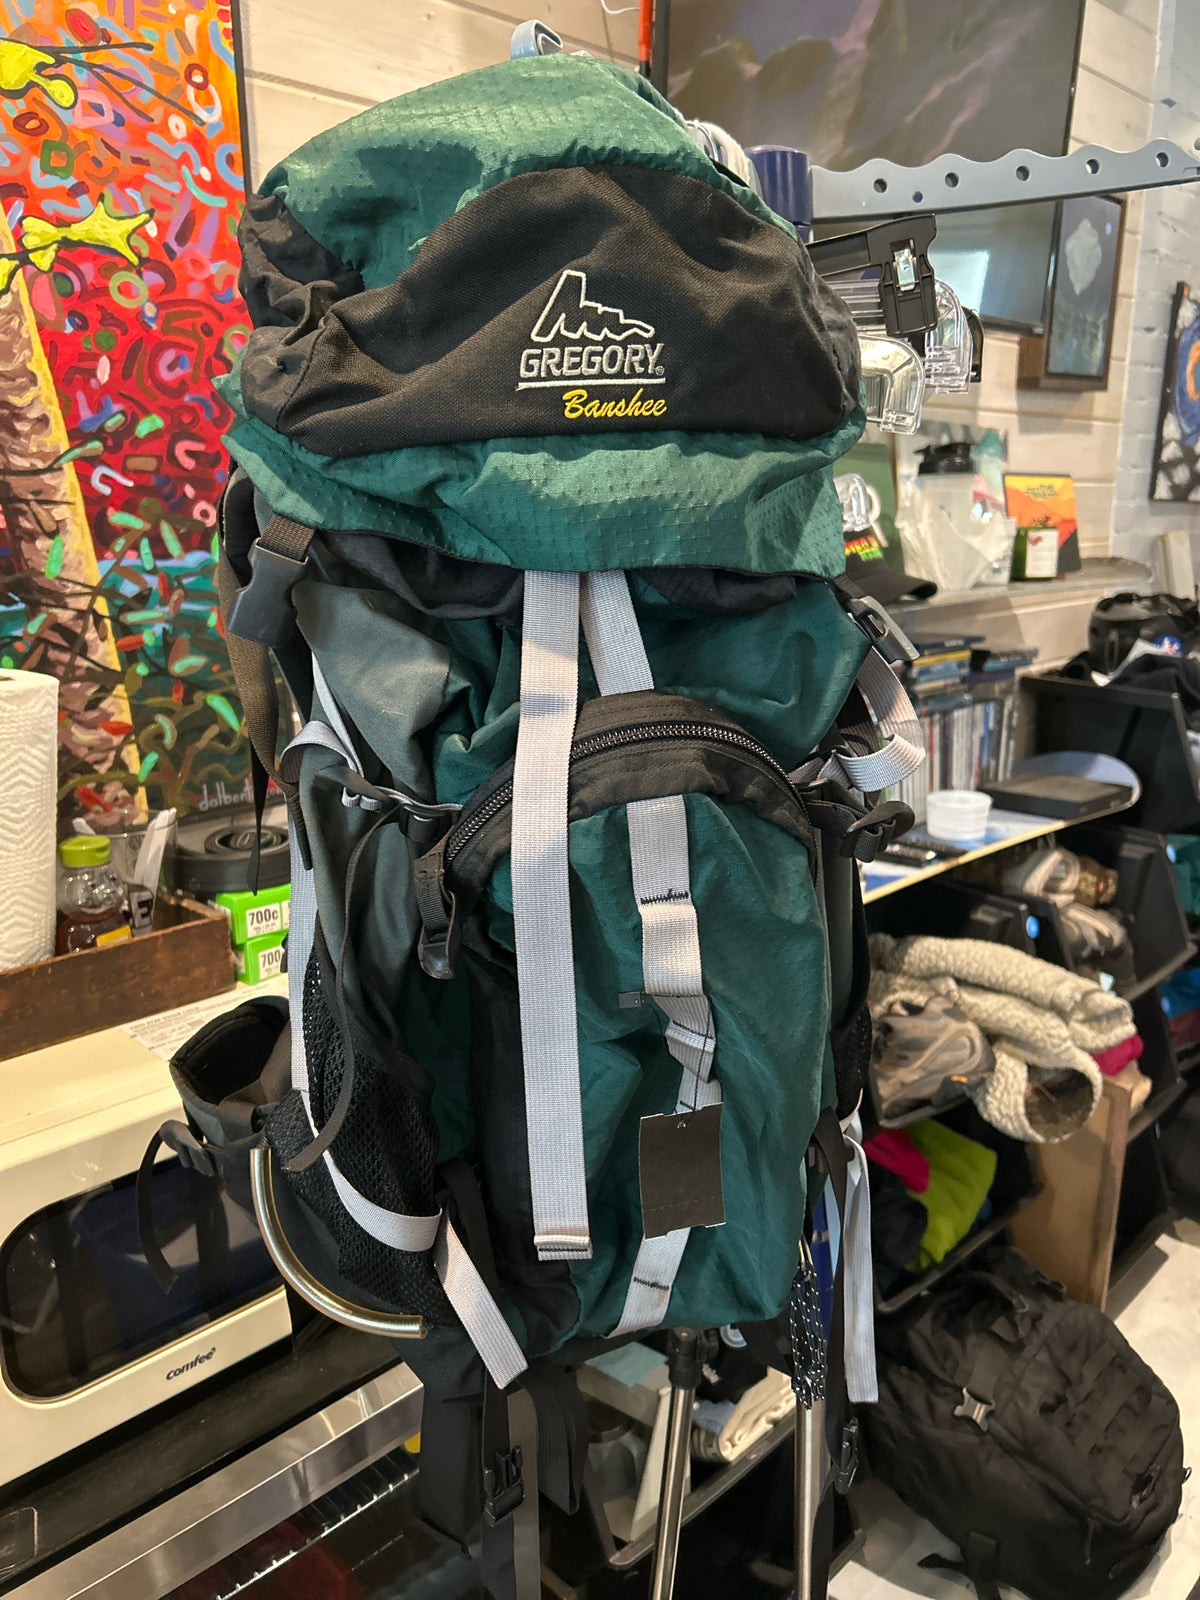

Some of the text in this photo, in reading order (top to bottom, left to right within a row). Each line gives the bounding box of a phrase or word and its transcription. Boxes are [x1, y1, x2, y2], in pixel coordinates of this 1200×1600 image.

[520, 343, 665, 378] GREGORY
[562, 388, 667, 419] Banshee
[248, 908, 279, 927] 700c
